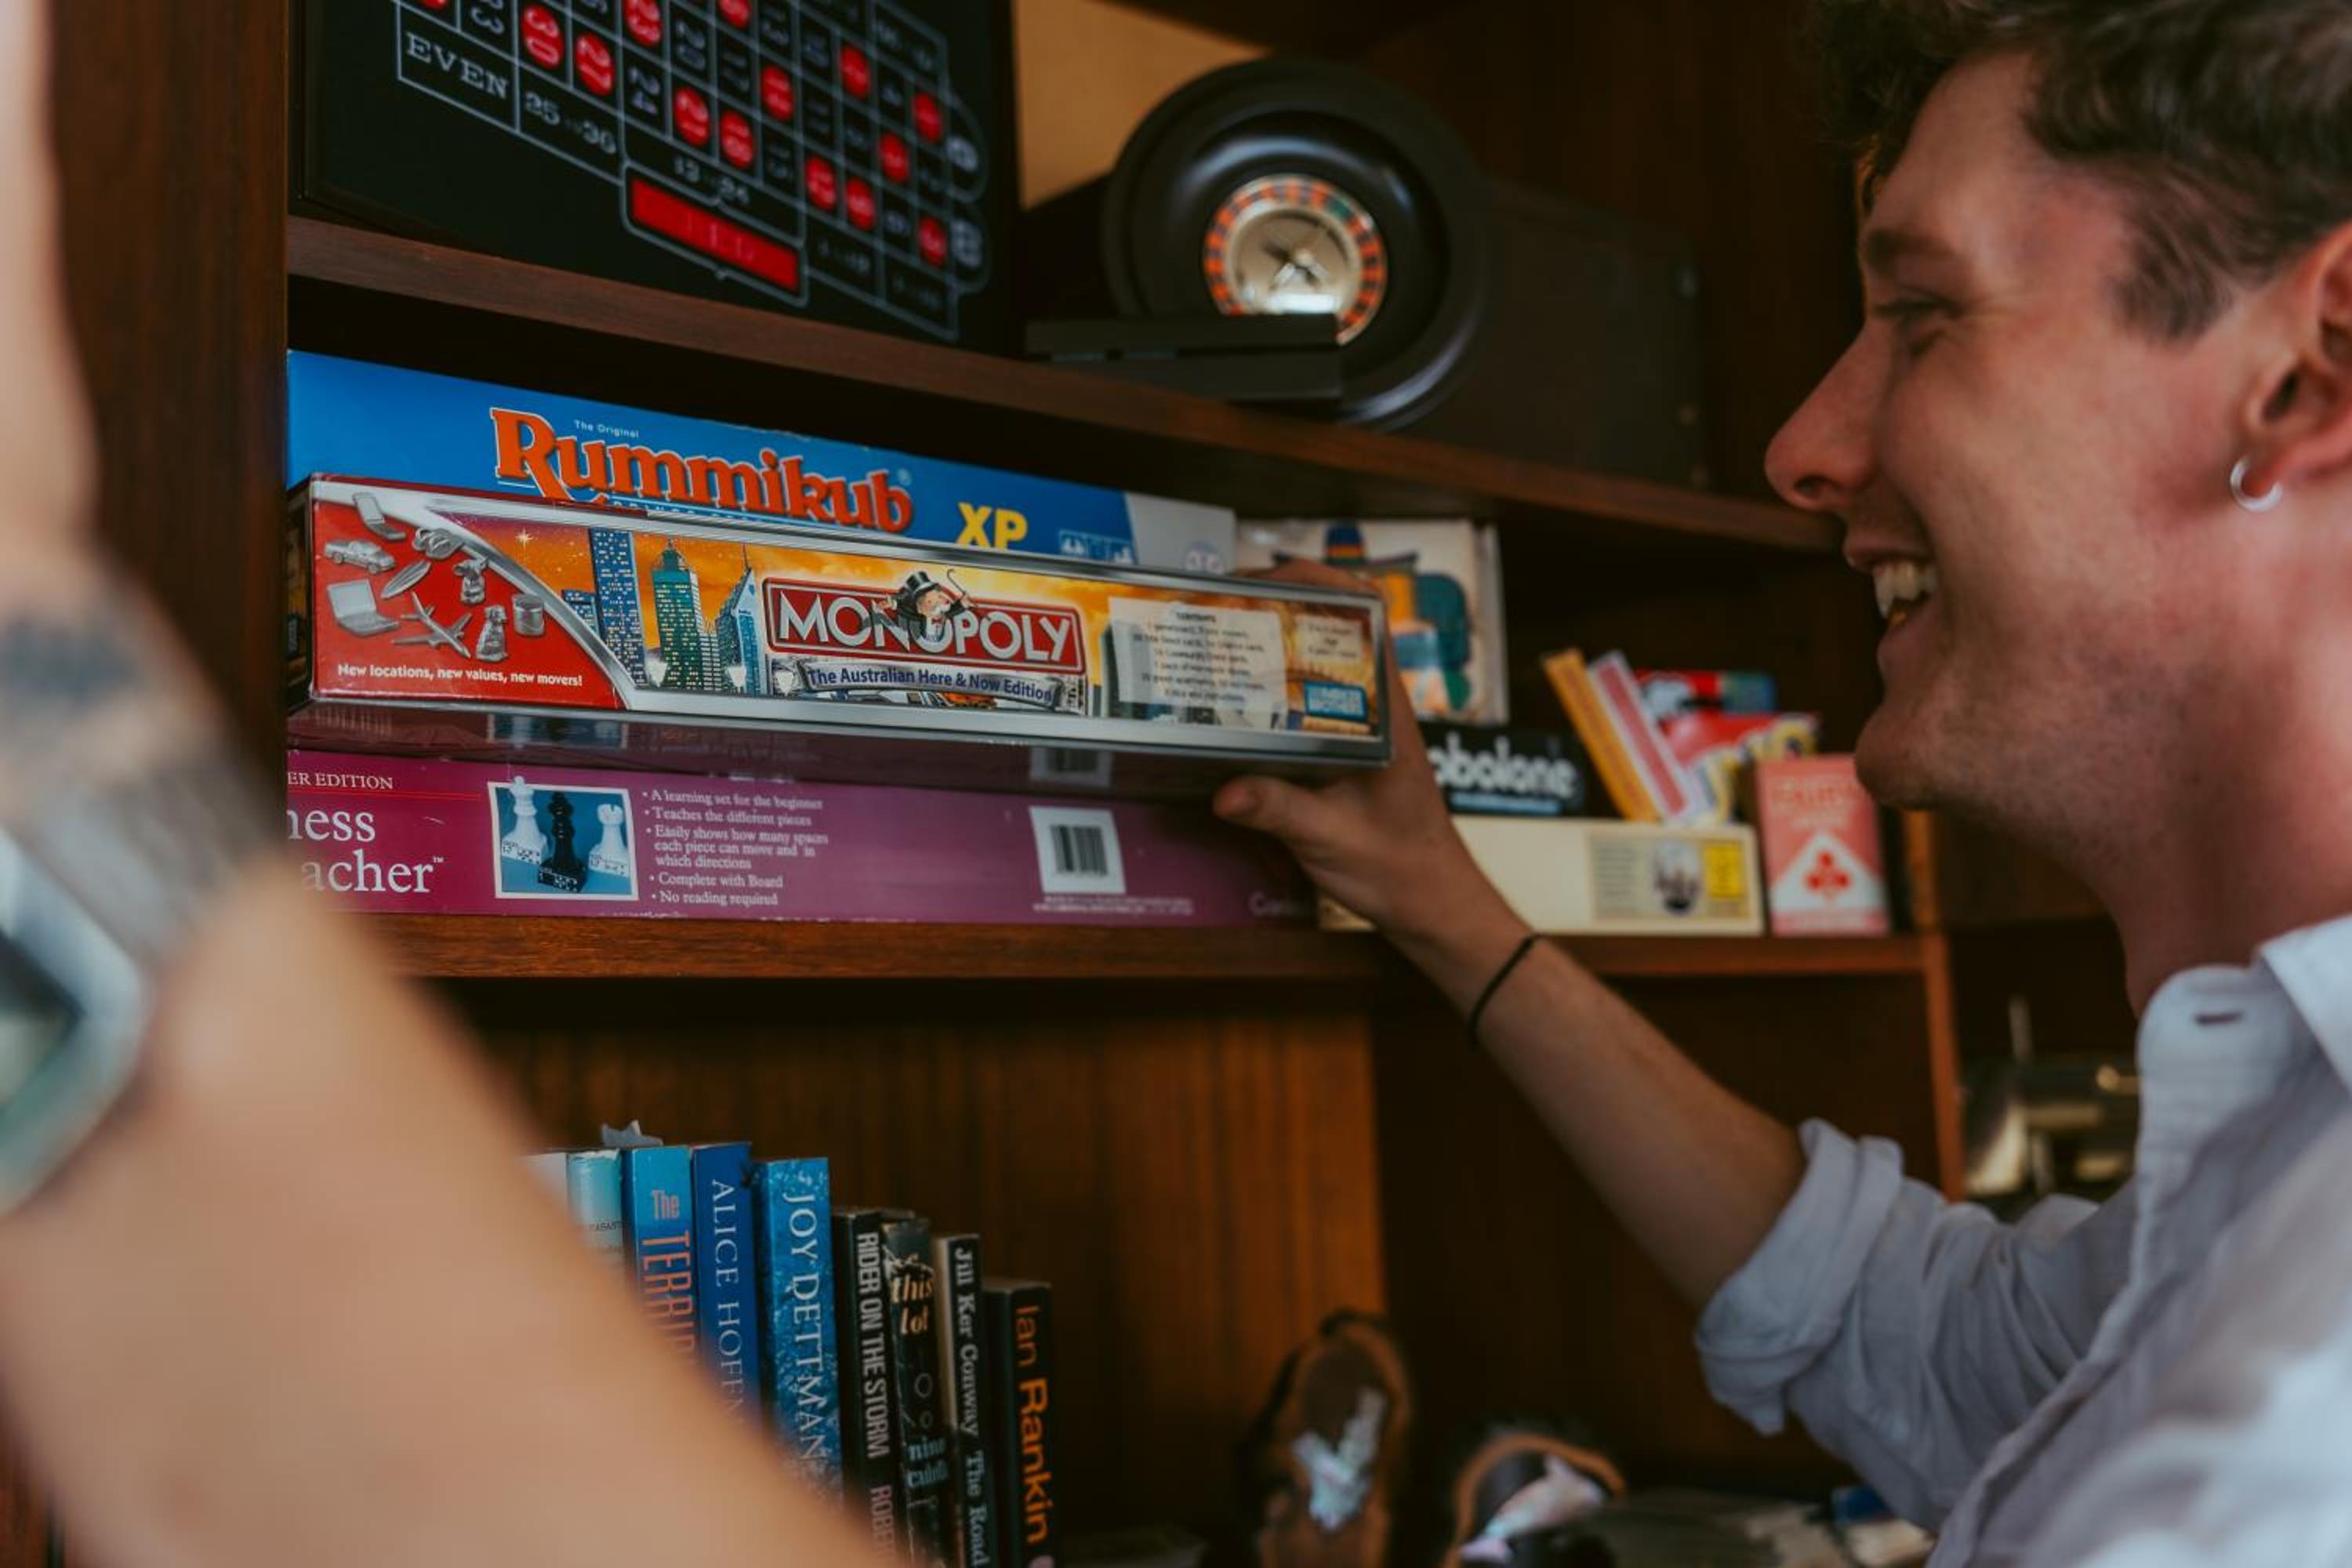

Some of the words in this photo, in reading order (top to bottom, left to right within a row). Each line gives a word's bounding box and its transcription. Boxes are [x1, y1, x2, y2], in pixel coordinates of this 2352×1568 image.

[524, 8, 560, 66] 30
[406, 32, 508, 100] EVEN
[577, 37, 612, 90] 27
[630, 66, 660, 115] 24
[573, 419, 594, 431] The
[598, 423, 639, 438] Original
[956, 502, 1028, 551] XP
[779, 590, 1071, 662] MONOPOLY
[338, 664, 366, 676] New
[369, 665, 434, 681] locations,
[437, 667, 463, 678] new
[466, 668, 508, 684] values,
[510, 672, 535, 683] new
[537, 673, 583, 687] movers!
[807, 669, 837, 686] The
[840, 668, 915, 684] Australian
[918, 670, 953, 688] Here
[956, 672, 967, 686] &
[969, 675, 1001, 692] Now
[1004, 677, 1055, 702] Edition
[287, 771, 310, 786] ER
[315, 773, 394, 789] EDITION
[652, 789, 662, 801] A
[664, 790, 713, 806] learning
[753, 794, 772, 808] the
[652, 807, 702, 821] Teaches
[706, 808, 724, 822] the
[727, 810, 775, 825] different
[655, 825, 690, 840] Easily
[692, 826, 728, 840] shows
[731, 828, 757, 841] how
[759, 832, 790, 844] many
[654, 840, 683, 851] each
[685, 840, 717, 857] piece
[719, 844, 740, 854] can
[742, 845, 773, 855] move
[776, 844, 797, 856] and
[804, 845, 816, 857] in
[655, 855, 692, 868] which
[695, 855, 752, 869] directions
[659, 873, 717, 887] Complete
[720, 875, 746, 887] with
[747, 875, 783, 888] Board
[659, 891, 680, 902] No
[683, 893, 728, 906] reading
[730, 894, 779, 908] required
[652, 1189, 681, 1221] The
[782, 1192, 818, 1261] JOY
[711, 1178, 739, 1287] ALICE
[856, 1232, 882, 1294] RIDER
[954, 1247, 975, 1287] Jill
[859, 1297, 884, 1331] ON
[956, 1293, 976, 1339] Ker
[1014, 1304, 1041, 1368] Ian
[791, 1272, 829, 1461] DETTMAN
[862, 1333, 886, 1377] THE
[958, 1343, 980, 1437] Conway
[864, 1377, 891, 1460] STORM
[966, 1449, 985, 1498] The
[1018, 1377, 1055, 1545] Rankin
